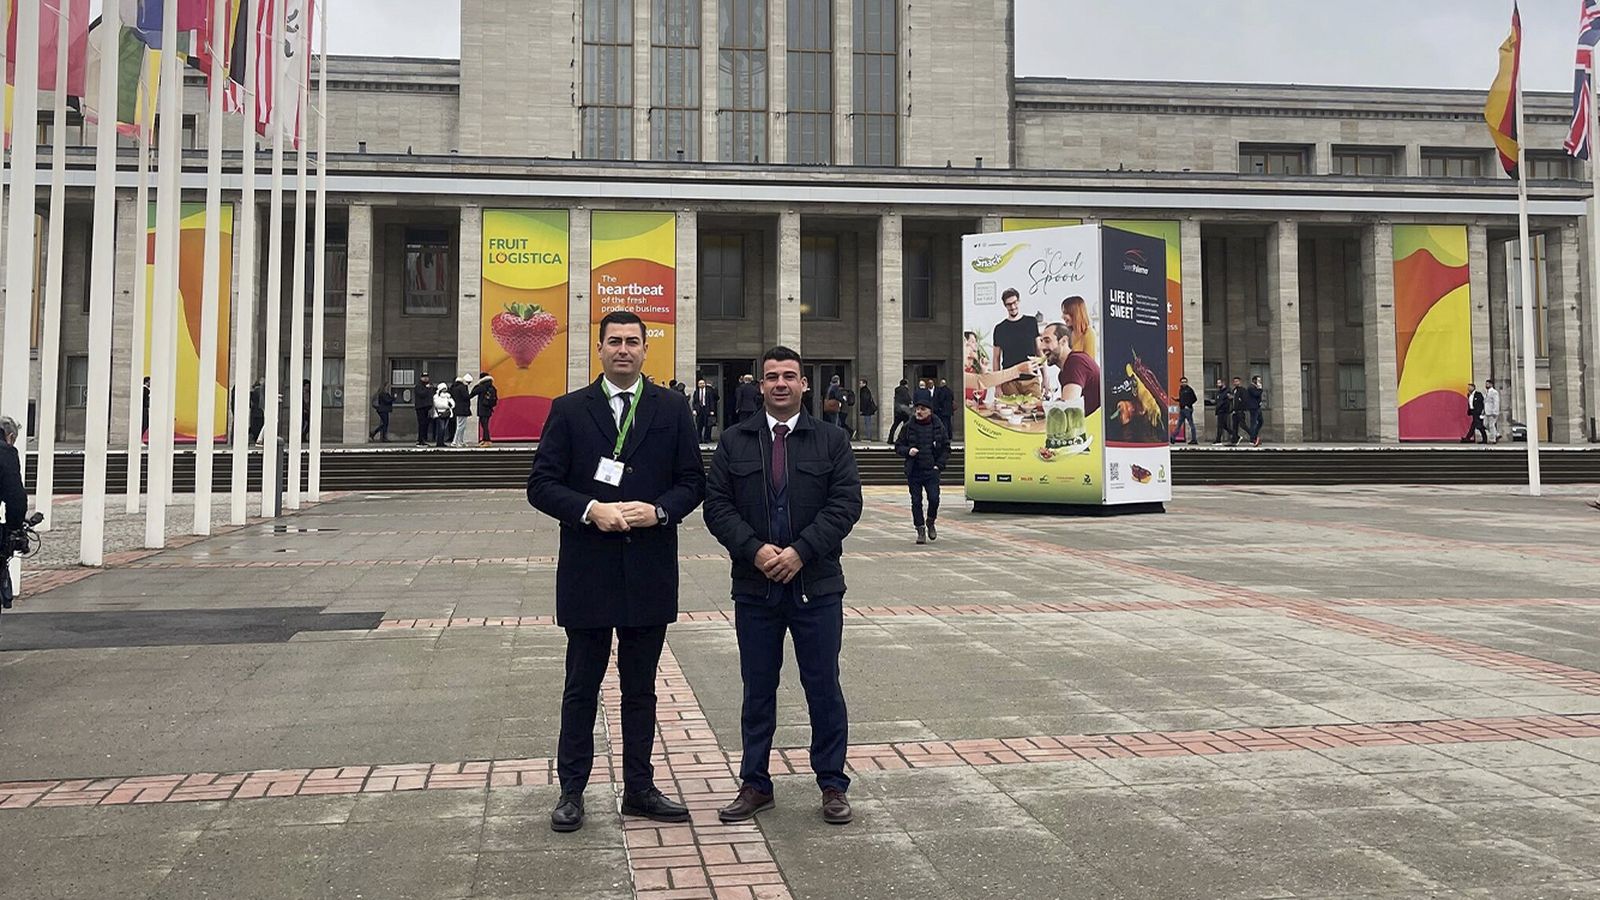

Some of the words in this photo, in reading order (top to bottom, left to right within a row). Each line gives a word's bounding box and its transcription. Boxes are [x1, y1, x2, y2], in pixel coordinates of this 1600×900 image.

[489, 238, 528, 250] FRUIT
[489, 251, 562, 265] LOGISTICA
[975, 254, 1003, 267] Snack
[1049, 250, 1082, 275] Cool
[602, 274, 617, 283] The
[1029, 259, 1085, 295] Spoon
[597, 282, 664, 296] heartbeat
[601, 296, 611, 304] of
[611, 296, 625, 304] the
[627, 296, 648, 304] fresh
[1110, 289, 1125, 304] LIFE
[1126, 291, 1133, 305] IS
[601, 305, 634, 314] produce
[635, 305, 670, 313] business
[1110, 304, 1134, 320] SWEET
